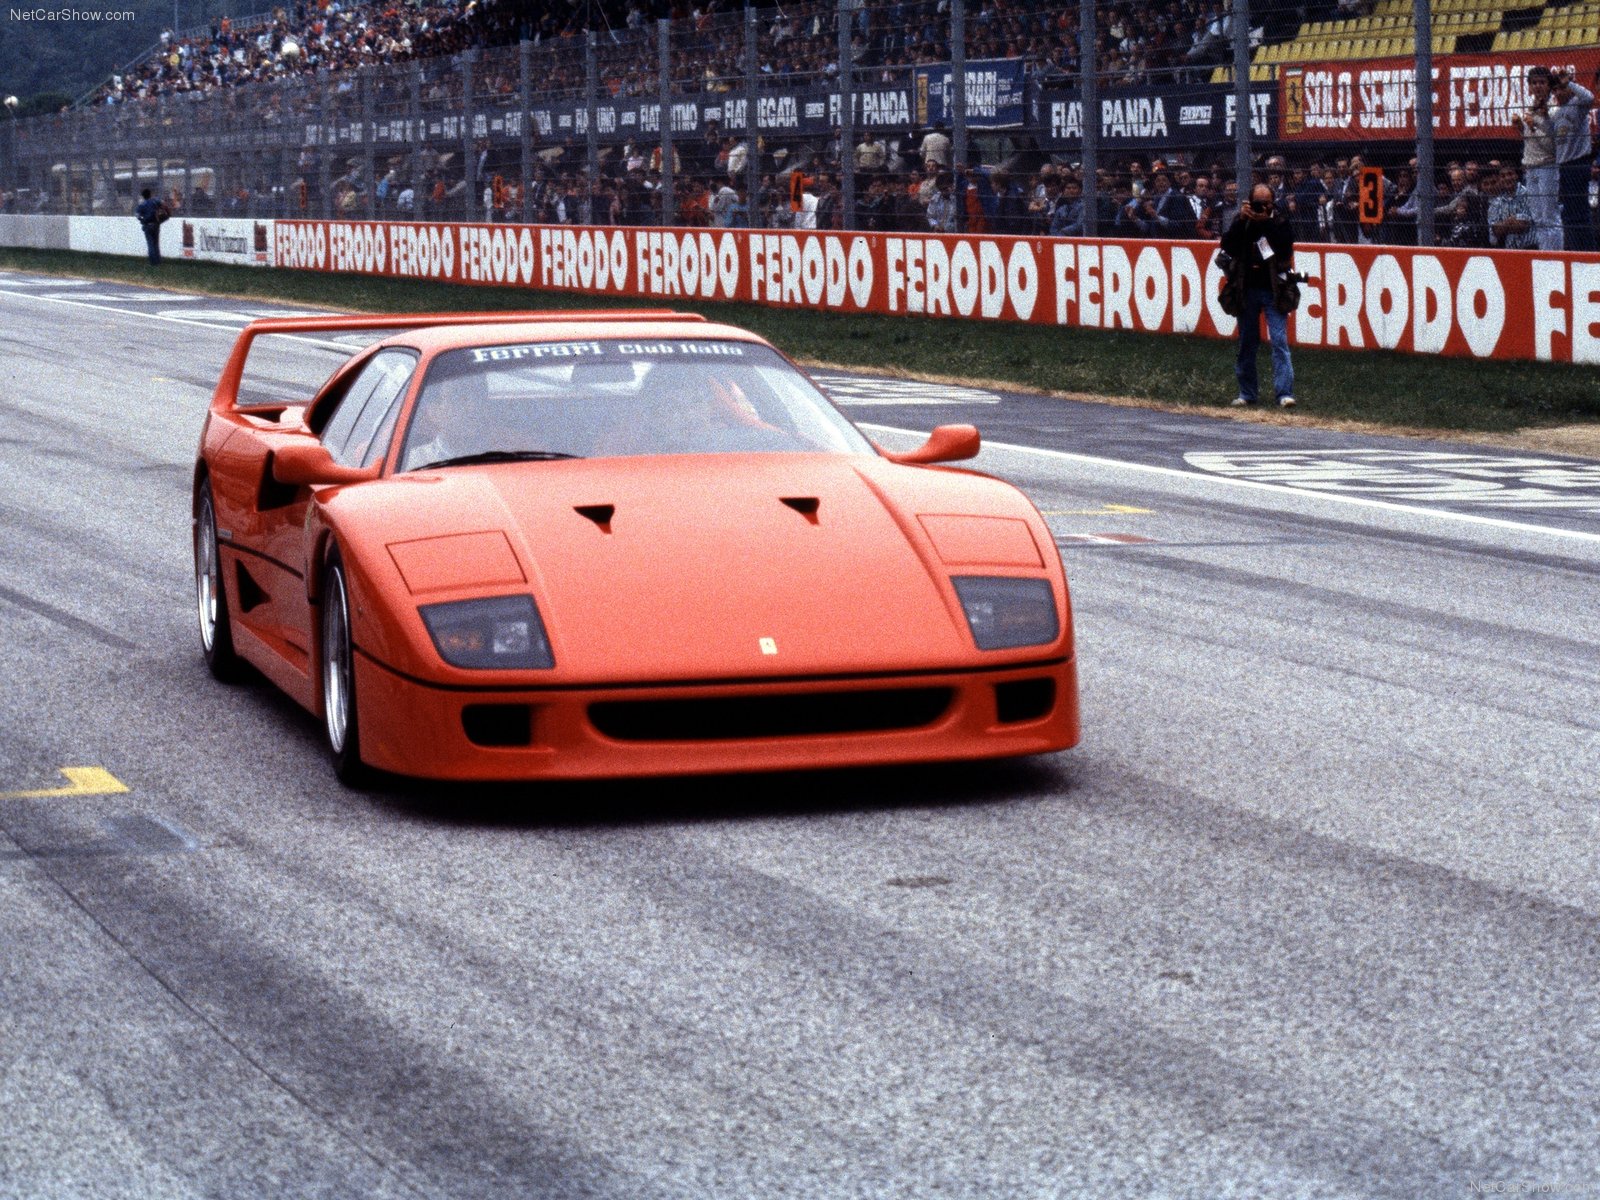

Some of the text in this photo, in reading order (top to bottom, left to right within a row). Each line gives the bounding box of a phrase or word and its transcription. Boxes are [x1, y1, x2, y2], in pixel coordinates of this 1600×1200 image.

[640, 103, 661, 132] FIAT
[724, 99, 748, 129] FIAT
[829, 93, 857, 126] FIT
[863, 91, 910, 125] PANDA
[1102, 98, 1168, 138] PANDA
[1225, 93, 1271, 136] FAT
[1304, 71, 1352, 128] SOLO
[1359, 69, 1440, 128] SEMPE
[1363, 172, 1379, 218] 3
[276, 223, 326, 269] FERODO
[329, 223, 387, 273] FERODO
[390, 225, 455, 278] FERODO
[459, 227, 534, 284] FERODO
[540, 229, 628, 291] FERODO
[636, 231, 739, 298] FERODO
[749, 234, 873, 308] FERODO
[886, 238, 1038, 320] FERODO
[1288, 251, 1506, 358] ERODO
[472, 342, 743, 363] Ferrari Club Italia
